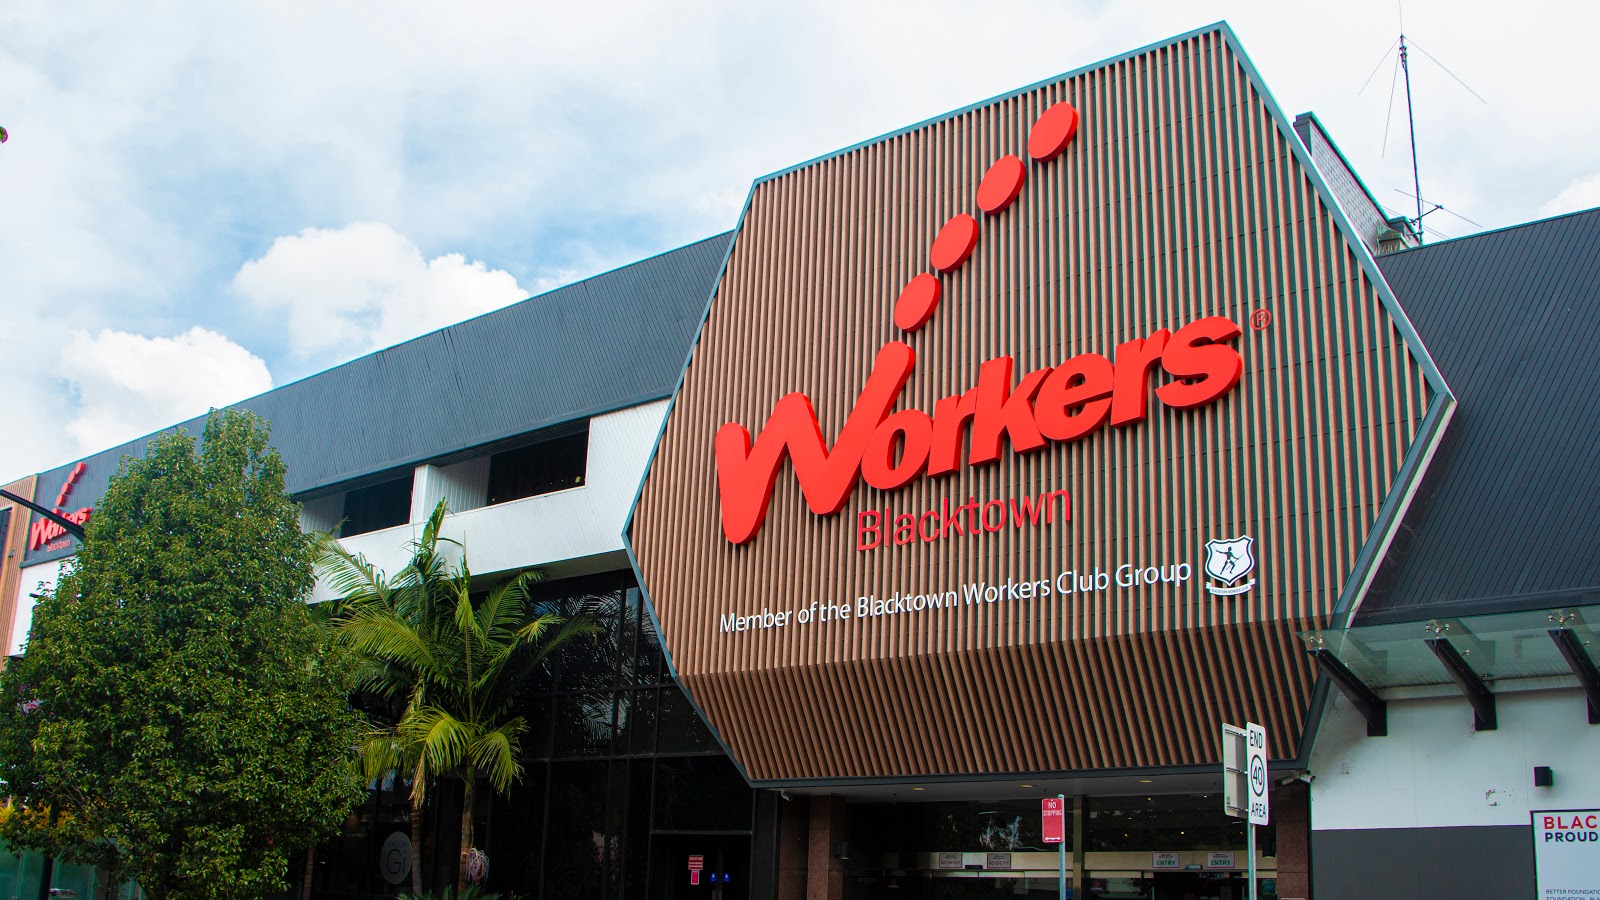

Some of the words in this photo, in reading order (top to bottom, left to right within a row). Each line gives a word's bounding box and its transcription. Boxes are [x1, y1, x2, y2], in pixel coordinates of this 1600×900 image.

[714, 315, 1242, 546] Workers
[856, 489, 1072, 551] Blacktown
[719, 606, 791, 633] Member
[797, 602, 819, 625] of
[819, 601, 851, 622] the
[857, 590, 958, 618] Blacktown
[963, 577, 1051, 606] Workers
[1056, 567, 1109, 595] Club
[1115, 561, 1192, 588] Group
[1250, 729, 1263, 749] END
[1253, 766, 1263, 786] 40
[1250, 803, 1267, 818] AREA
[1543, 815, 1598, 830] BLAC
[1544, 831, 1599, 842] PROUD
[386, 849, 406, 874] Gi
